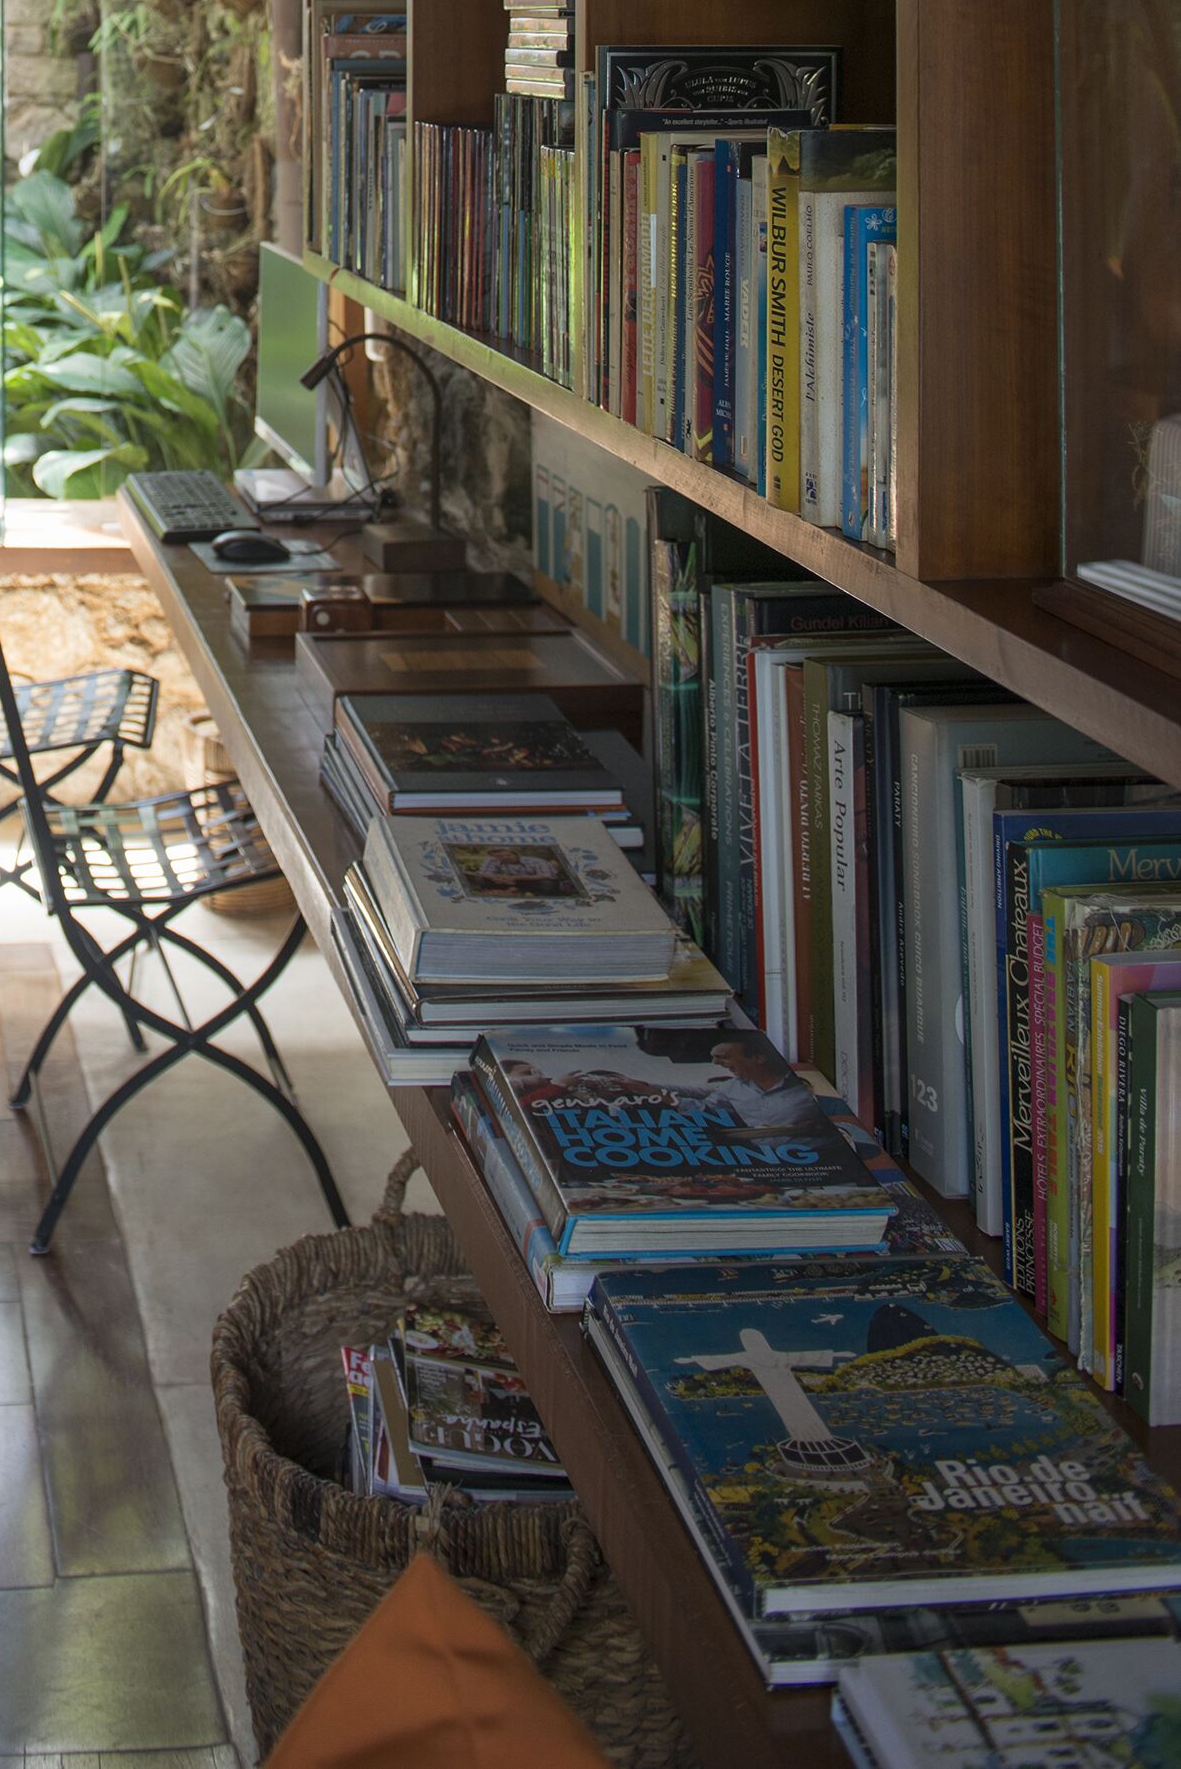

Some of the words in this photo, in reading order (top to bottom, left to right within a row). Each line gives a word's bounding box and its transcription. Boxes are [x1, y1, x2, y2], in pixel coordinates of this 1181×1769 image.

[672, 118, 694, 126] excellent
[771, 186, 787, 273] WILBUR
[805, 204, 814, 250] COELHO
[806, 251, 814, 287] PAULO
[740, 276, 750, 349] VADER
[771, 275, 787, 348] SMITH
[771, 353, 785, 422] DESERT
[771, 424, 785, 464] GOD
[790, 615, 845, 632] Gundel
[709, 678, 718, 728] Alberto
[709, 731, 719, 766] Pinto
[811, 702, 823, 771] THOMAZ
[834, 740, 847, 790] Arte
[709, 769, 719, 840] Corporate
[813, 773, 824, 829] FARKAS
[893, 781, 902, 828] PARATY
[910, 752, 920, 848] CANCIONEIRO
[439, 820, 550, 835] jamie
[833, 800, 849, 892] Popular
[995, 834, 1003, 868] DRIVING
[913, 850, 922, 928] SONGBOOK
[996, 868, 1004, 910] AMBITION
[1009, 857, 1030, 988] Chateaux
[1046, 916, 1057, 966] THE
[914, 931, 923, 974] CHICO
[1032, 922, 1044, 974] BUDGET
[915, 976, 925, 1045] BUARQUE
[1066, 961, 1078, 1033] FABIAN
[1096, 974, 1105, 1019] Summer
[1046, 971, 1057, 1107] BRAZILIAN
[1096, 1019, 1105, 1074] Exhibition
[1118, 1015, 1128, 1056] DIEGO
[910, 1073, 939, 1115] 123
[1011, 993, 1034, 1155] Merveilleux
[1034, 1031, 1047, 1149] EXTRAORDINAIRES
[1118, 1059, 1128, 1103] RIVERA
[531, 1089, 680, 1115] gennaro's
[544, 1108, 737, 1130] ITALIAN
[1137, 1088, 1147, 1117] Villa
[1139, 1118, 1147, 1133] de
[555, 1126, 713, 1148] HOME
[562, 1144, 821, 1168] COOKING
[1047, 1112, 1059, 1197] TABLE
[1137, 1135, 1148, 1177] Paraty
[1037, 1153, 1048, 1201] HOTELS
[1015, 1217, 1026, 1290] EDITIONS
[1024, 1211, 1036, 1296] PRINCESSE
[1116, 1342, 1124, 1383] TASCHEN
[910, 1478, 1097, 1511] Janeiro
[935, 1457, 1019, 1487] Rio
[1030, 1455, 1091, 1483] de
